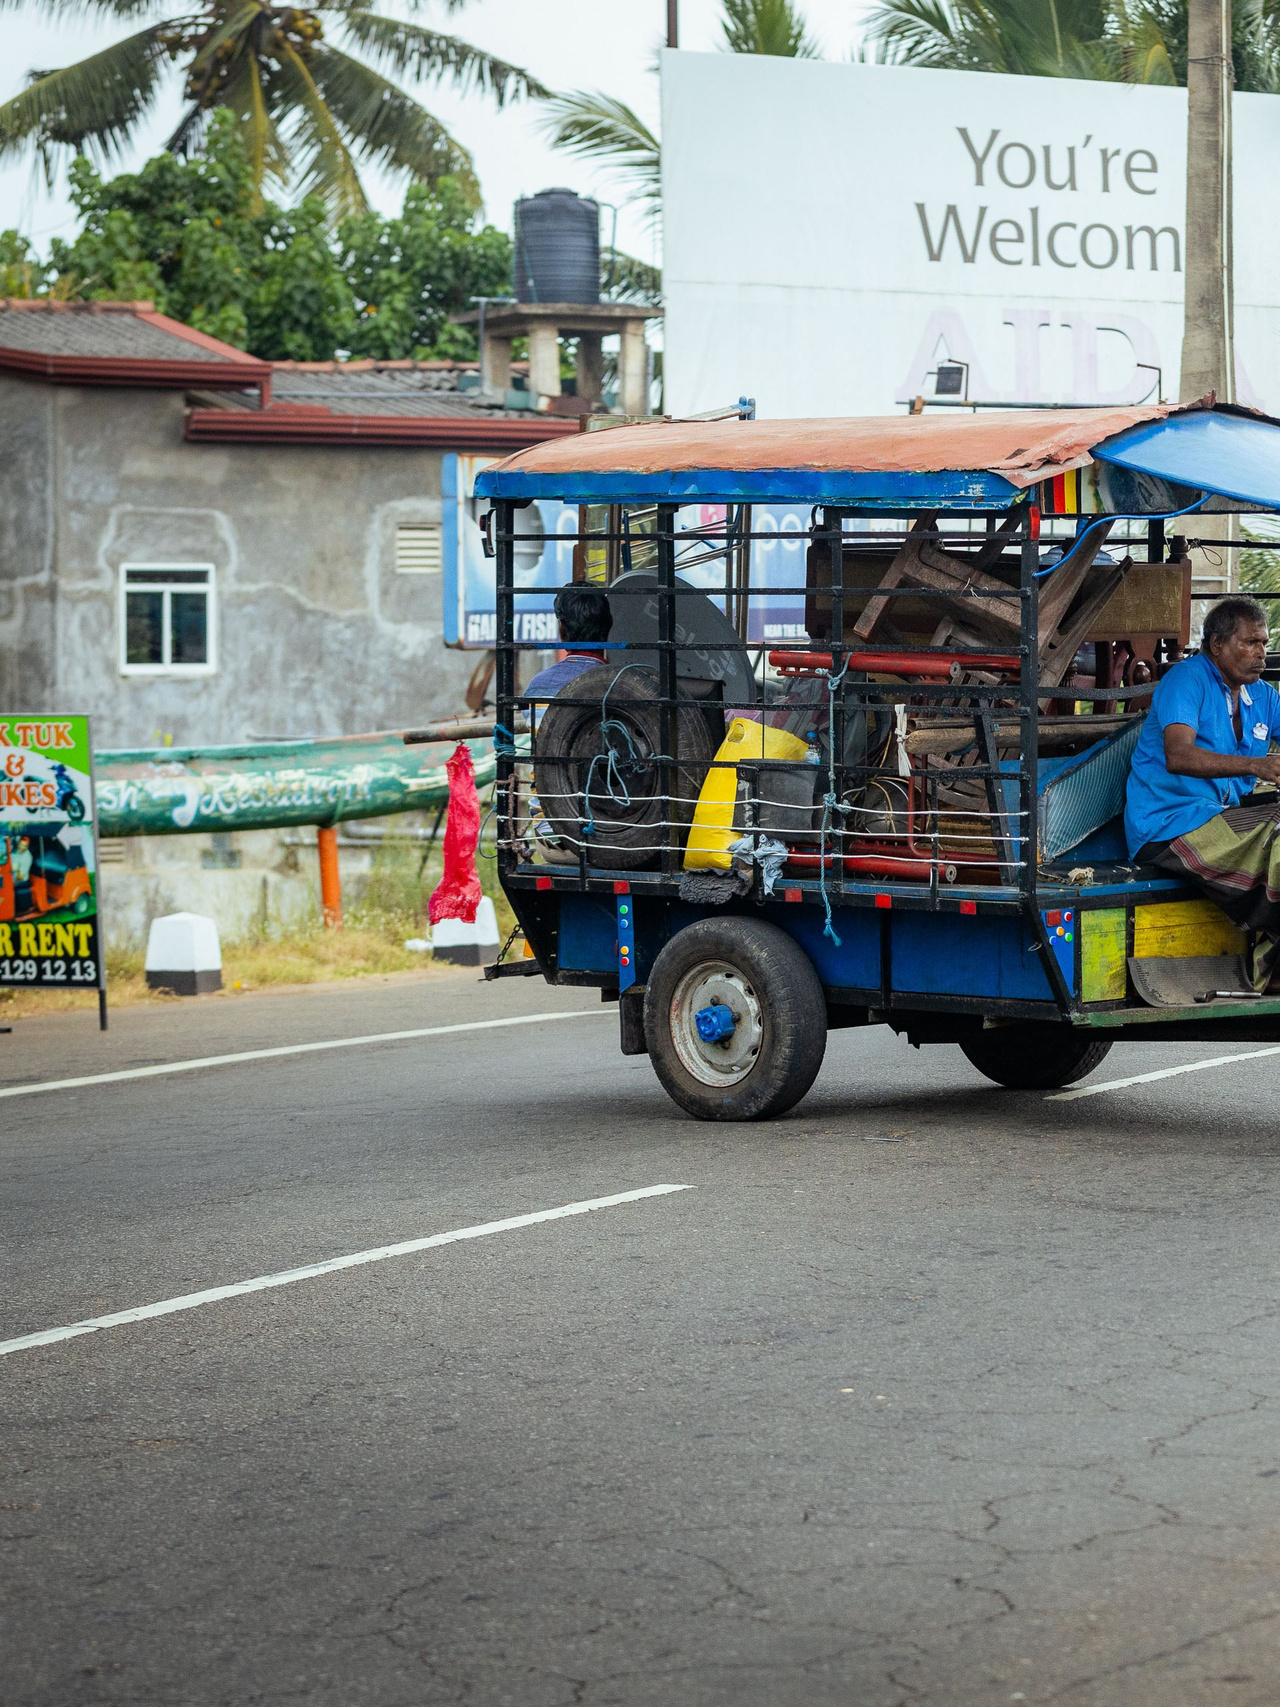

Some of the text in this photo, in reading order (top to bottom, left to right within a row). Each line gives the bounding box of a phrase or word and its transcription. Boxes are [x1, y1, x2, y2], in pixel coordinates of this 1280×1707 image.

[956, 126, 1159, 195] You're
[914, 202, 1182, 273] Welcom
[895, 308, 1264, 408] AID
[467, 612, 559, 642] HAY FISH
[15, 723, 75, 747] TUK
[5, 753, 26, 777] &
[18, 922, 94, 958] RENT
[41, 959, 67, 981] 12
[70, 959, 97, 981] 13
